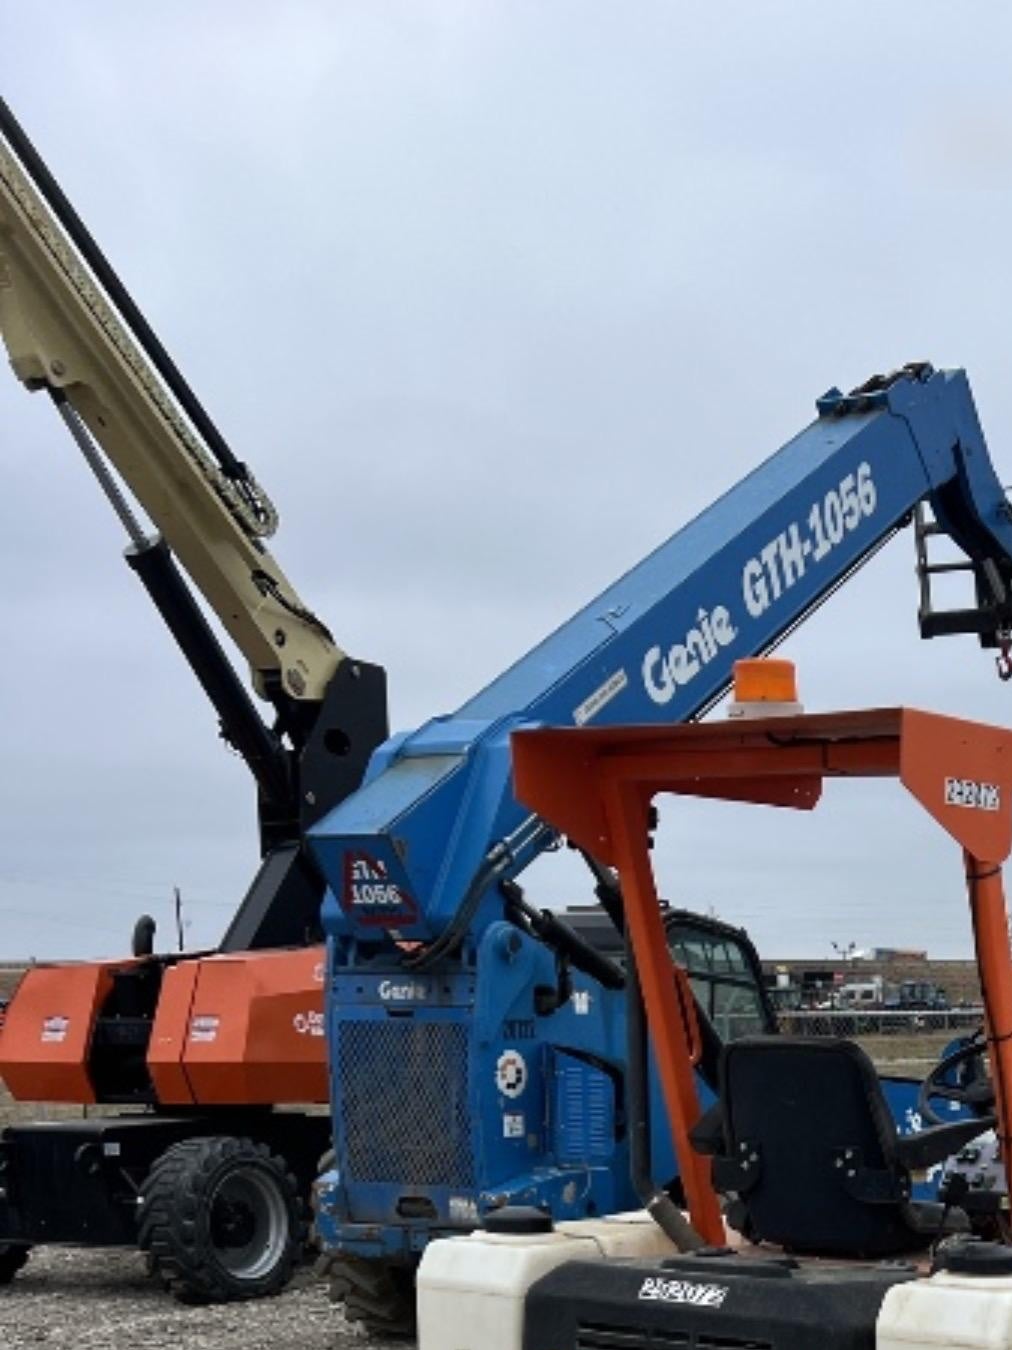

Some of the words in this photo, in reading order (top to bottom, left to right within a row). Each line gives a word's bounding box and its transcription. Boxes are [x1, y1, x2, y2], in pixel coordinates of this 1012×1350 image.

[642, 605, 739, 705] Genie
[742, 461, 877, 618] GTH-1056
[352, 884, 402, 904] 1056
